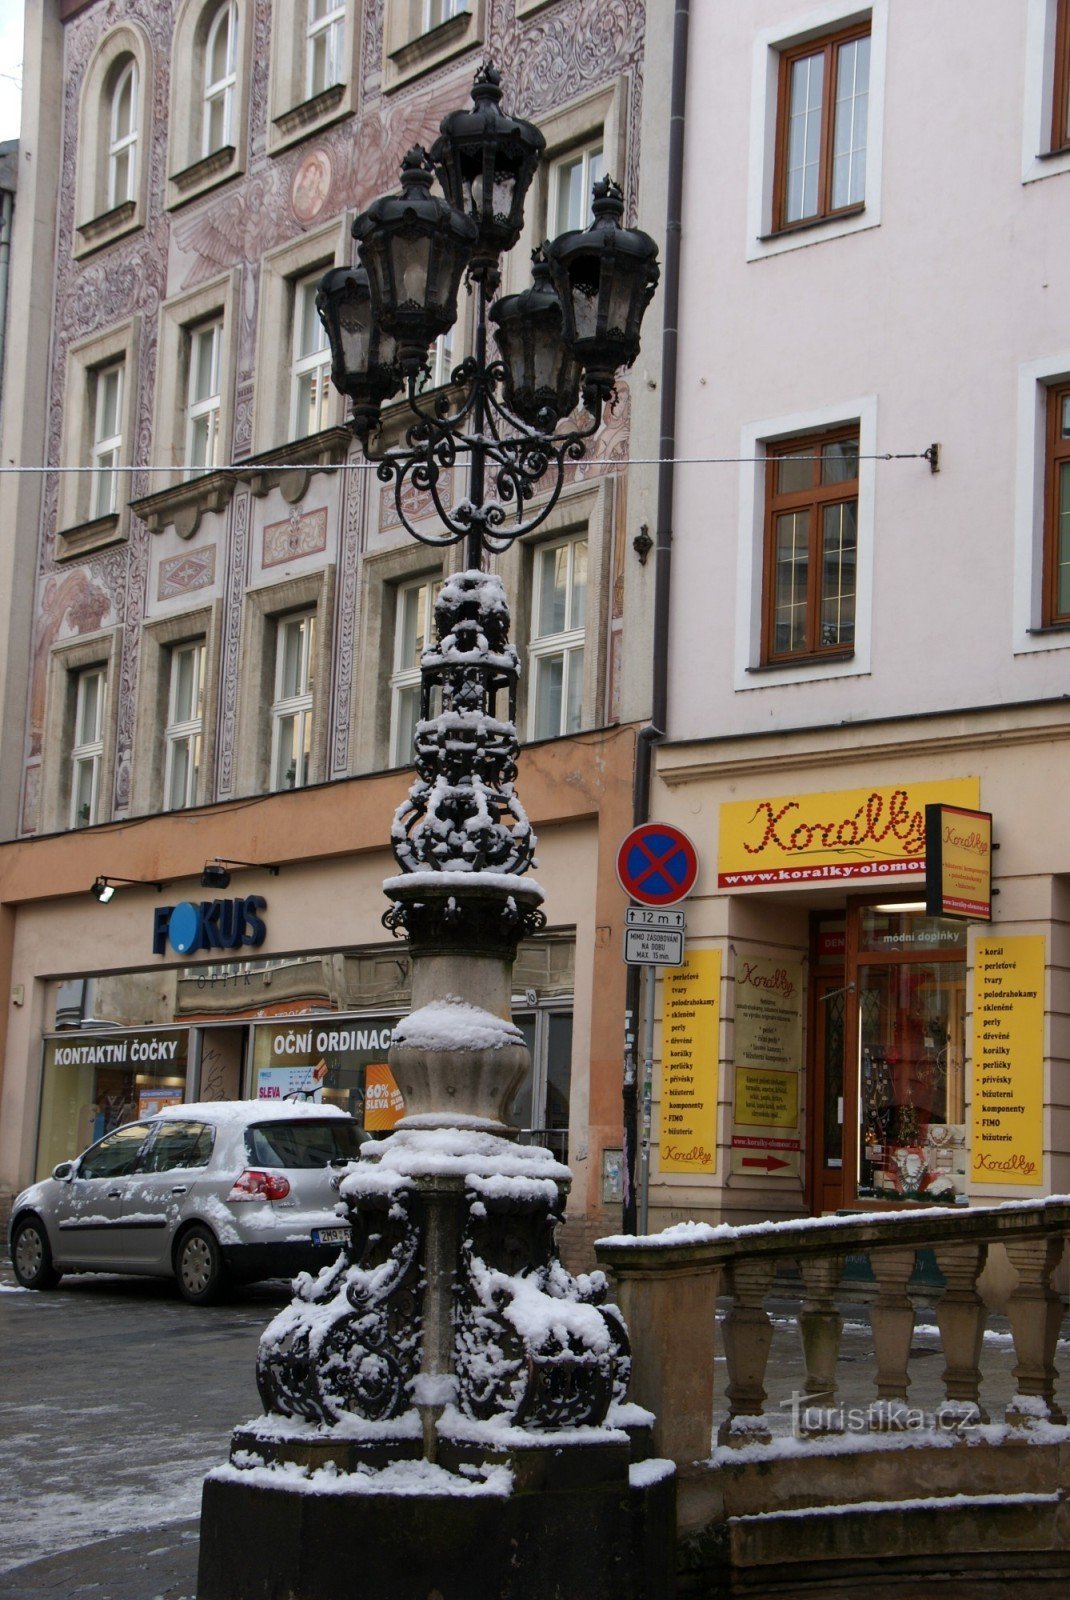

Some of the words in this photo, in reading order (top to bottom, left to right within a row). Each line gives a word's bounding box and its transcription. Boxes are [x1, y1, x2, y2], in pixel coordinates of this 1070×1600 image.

[743, 790, 926, 854] Korálky
[642, 911, 654, 923] 12
[658, 915, 669, 924] m
[153, 894, 267, 956] FOKUS
[630, 933, 644, 941] MIMO
[646, 933, 679, 943] ZÁSOBOVÁNÍ
[883, 932, 914, 943] módní
[918, 930, 960, 942] doplňky
[651, 943, 665, 951] DOBU
[985, 947, 1003, 956] korál
[984, 961, 1016, 971] perleťové
[197, 970, 251, 990] OPTIK
[738, 962, 795, 998] Korálky
[984, 977, 1003, 985] tvary
[671, 987, 687, 995] tvary
[984, 990, 1037, 999] polodrahokamy
[671, 998, 715, 1007] polodrahokamy
[983, 1003, 1013, 1012] skleněné
[983, 1019, 1001, 1027] perly
[671, 1024, 686, 1032] perly
[983, 1031, 1010, 1040] dřevěné
[274, 1030, 313, 1055] OČNÍ
[54, 1040, 127, 1065] KONTAKTNÍ
[130, 1038, 178, 1061] ČOČKY
[670, 1050, 692, 1058] korálky
[983, 1046, 1010, 1055] korálky
[983, 1061, 1011, 1070] perličky
[982, 1076, 1012, 1084] přívěsky
[259, 1086, 280, 1098] SLEVA
[366, 1083, 389, 1099] 60%
[982, 1090, 1013, 1098] bižuterní
[366, 1099, 389, 1109] SLEVA
[669, 1102, 703, 1110] komponenty
[982, 1105, 1025, 1113] komponenty
[982, 1119, 1000, 1127] FIMO
[982, 1133, 1012, 1141] bižuterie
[662, 1145, 712, 1164] Korálky
[974, 1153, 1036, 1175] Korálky
[321, 1230, 338, 1241] 2M9
